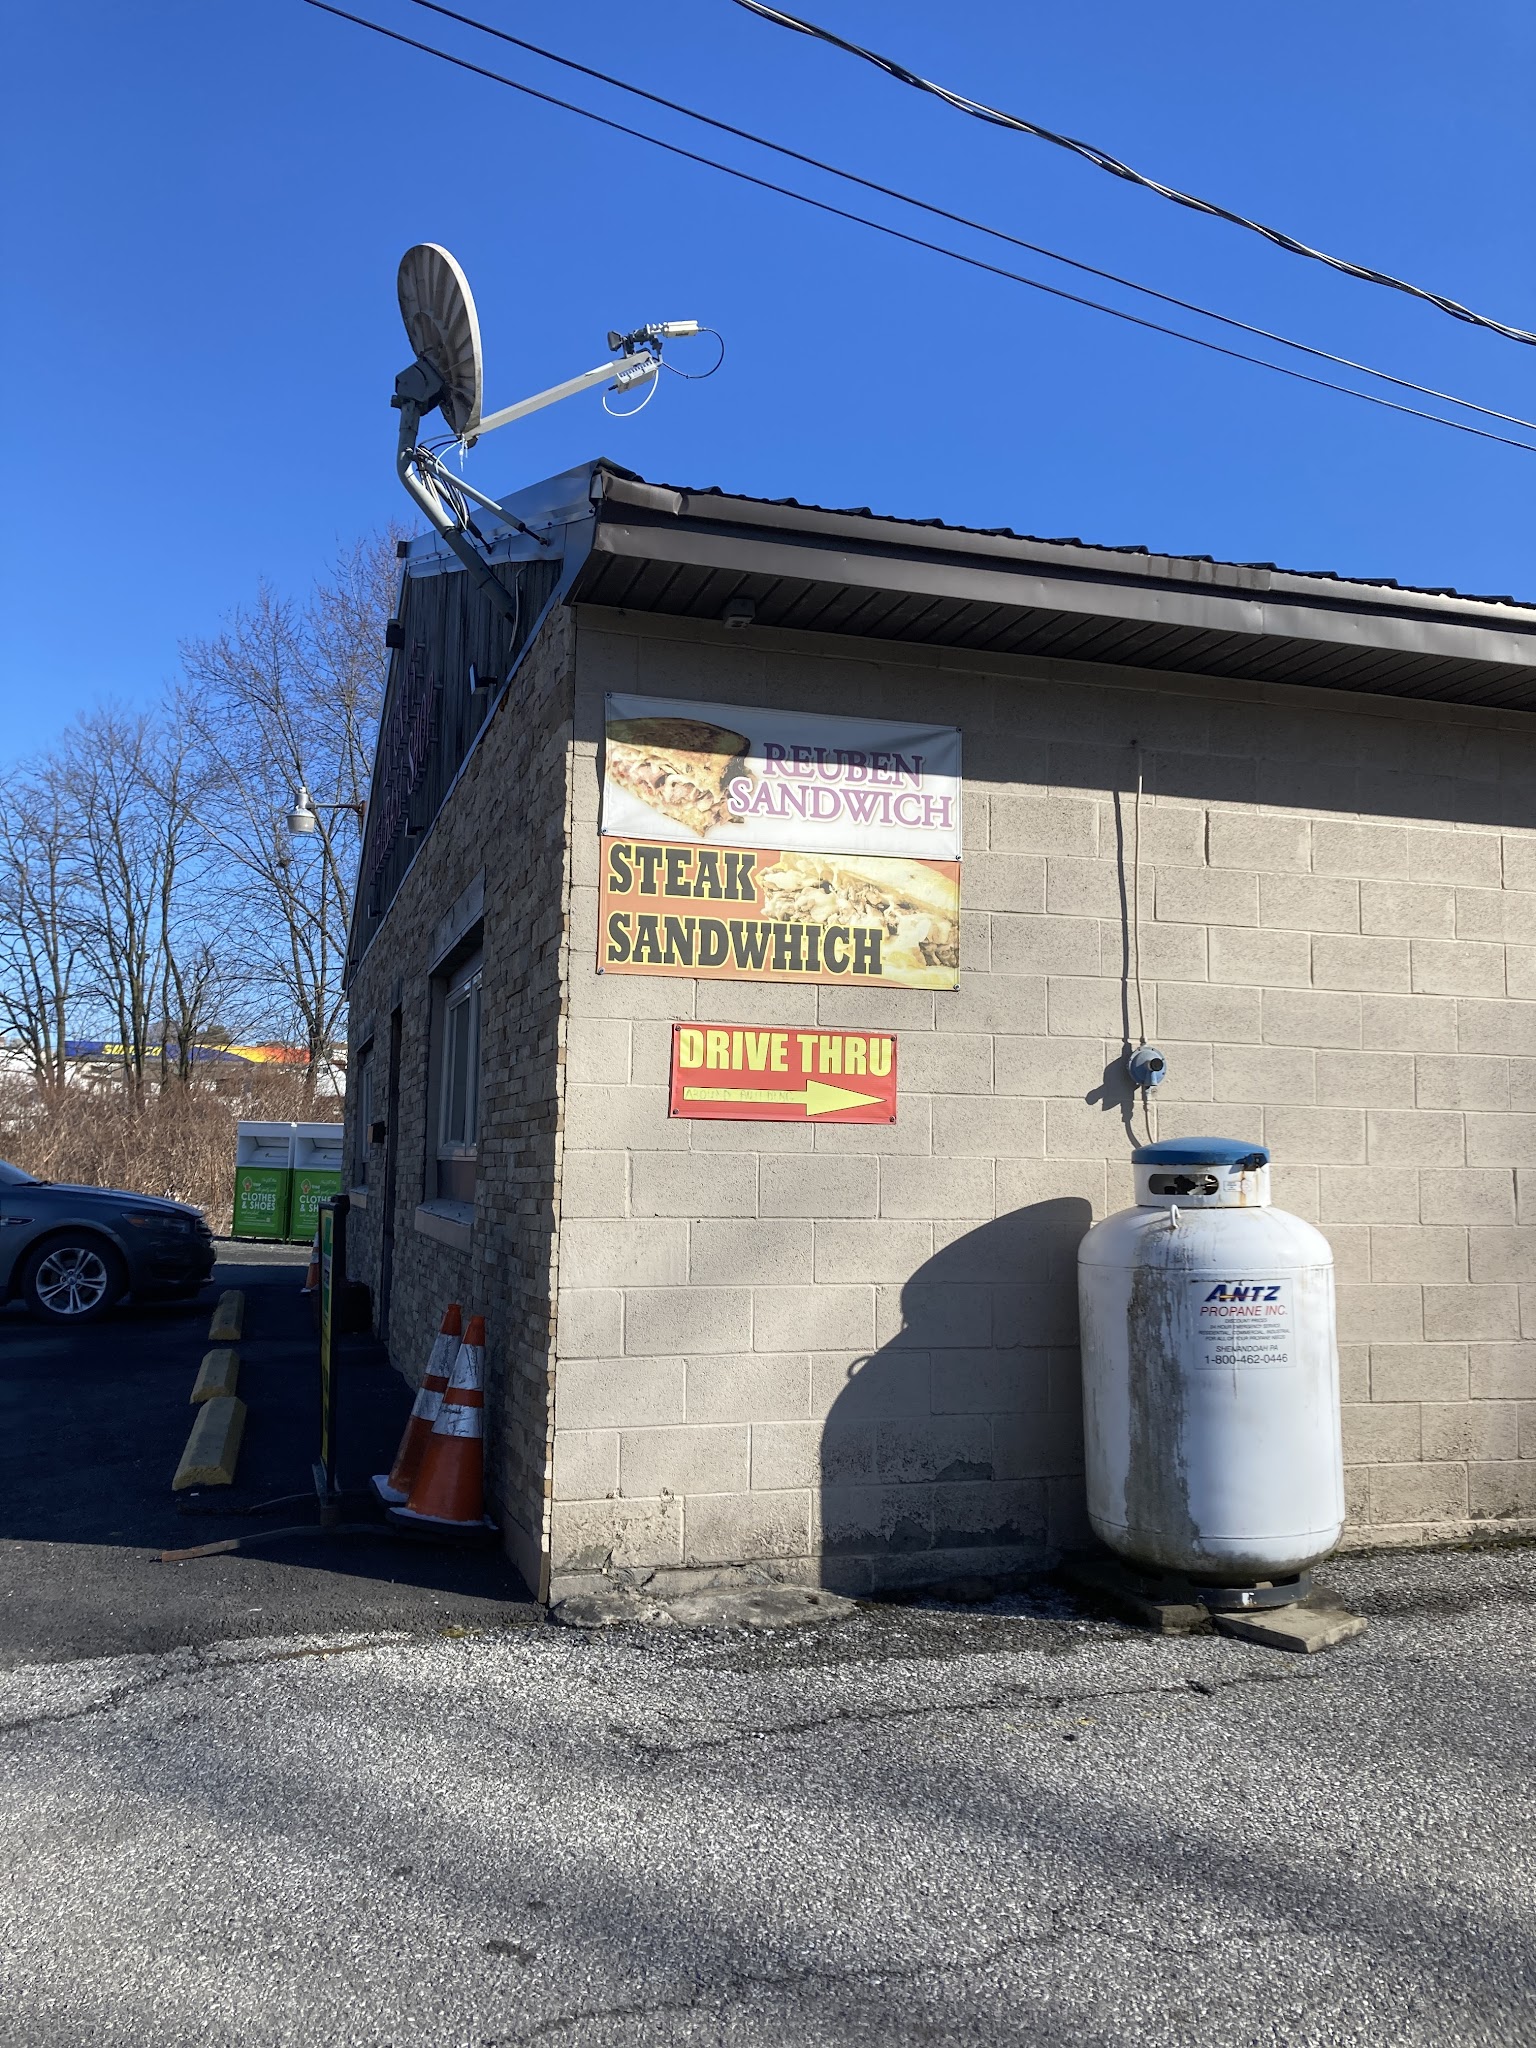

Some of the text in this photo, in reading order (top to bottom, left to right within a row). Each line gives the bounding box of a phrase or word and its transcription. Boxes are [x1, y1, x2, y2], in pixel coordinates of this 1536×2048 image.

[763, 742, 923, 788] REUBEN
[730, 778, 953, 829] SANDWICH
[608, 843, 757, 903] STEAK
[607, 912, 884, 976] SANDWHICH
[102, 1044, 162, 1056] SUCO
[679, 1029, 893, 1077] DRIVE THRU
[241, 1192, 276, 1202] CLOTHES
[299, 1195, 331, 1204] CLOTHE
[241, 1201, 276, 1210] & SHOES
[299, 1204, 305, 1212] &
[1205, 1284, 1281, 1302] ANTZ
[1200, 1305, 1288, 1317] PROPANE INC.
[1205, 1354, 1288, 1364] 1-800-462-0446
